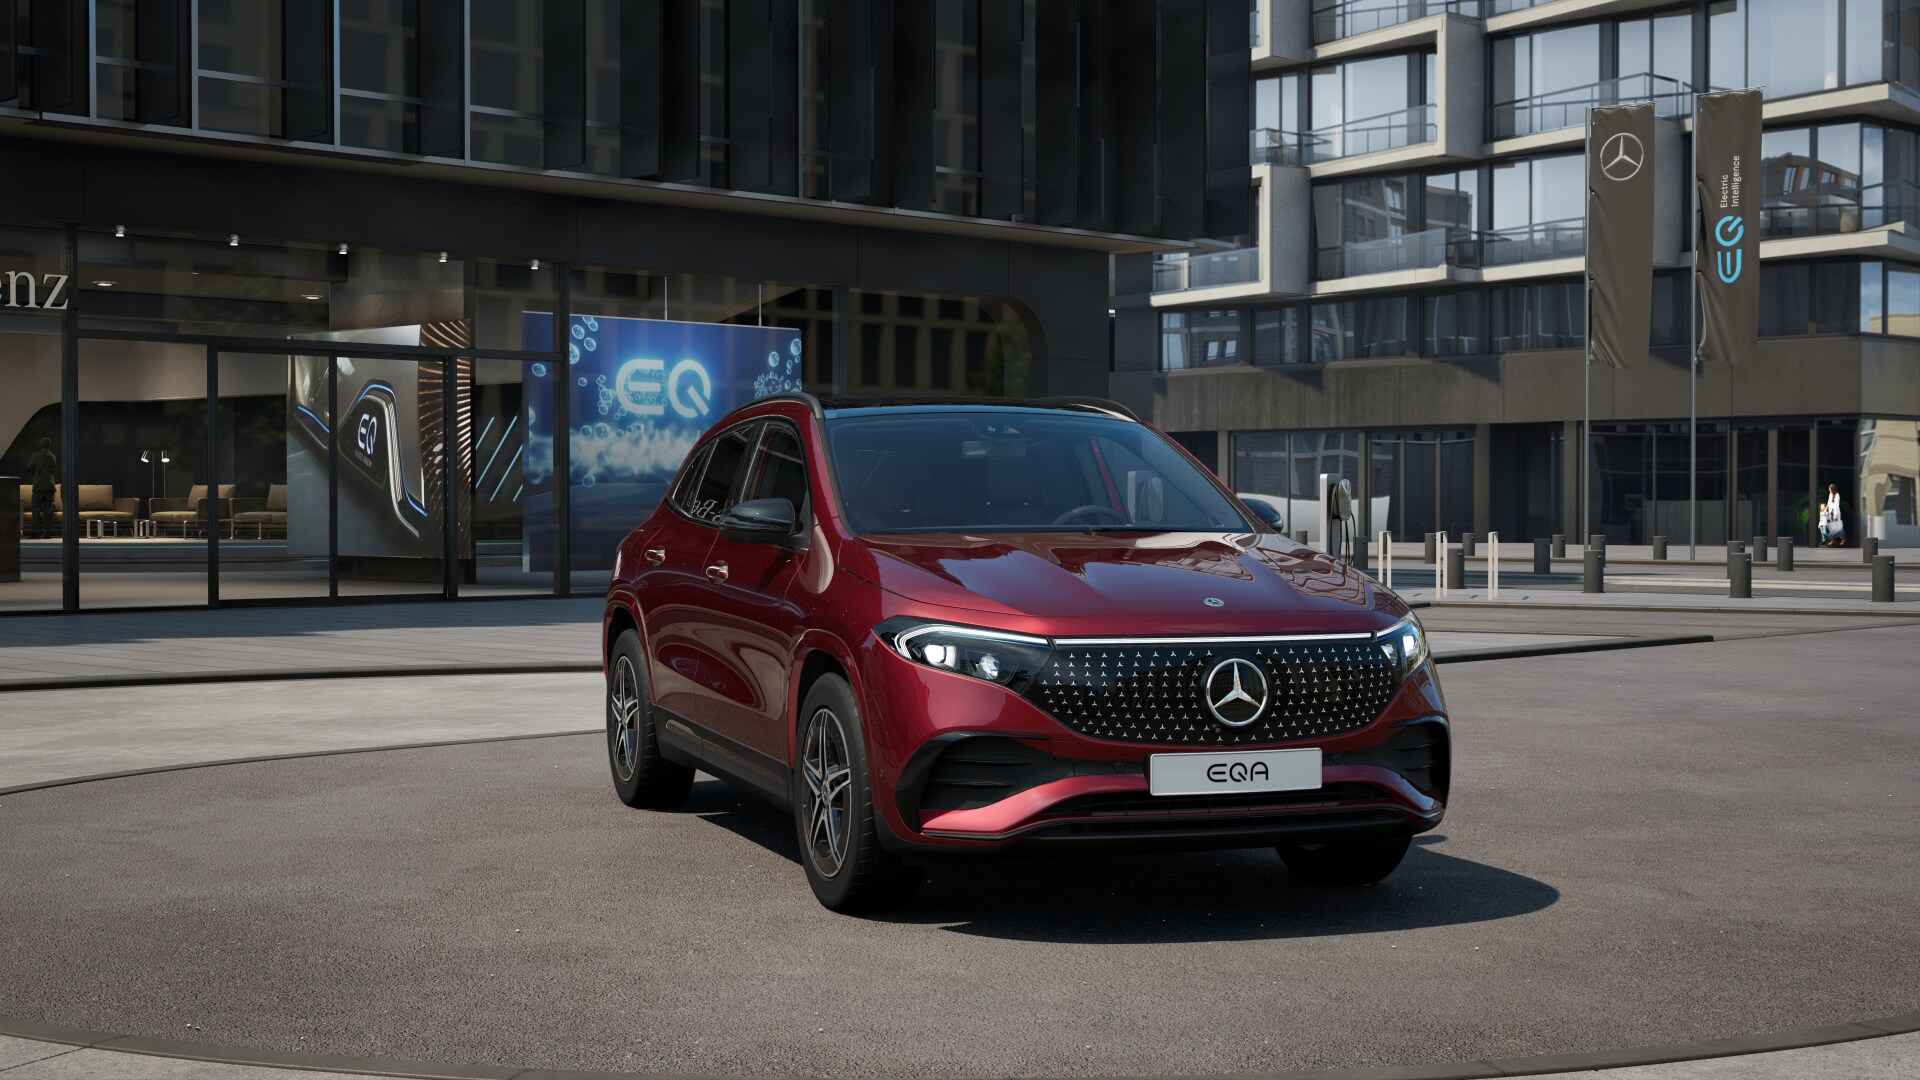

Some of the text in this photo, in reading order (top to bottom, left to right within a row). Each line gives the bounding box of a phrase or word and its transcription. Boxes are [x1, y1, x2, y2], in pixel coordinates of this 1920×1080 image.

[1720, 174, 1728, 208] Electric
[1731, 155, 1741, 207] Intelligence
[1715, 215, 1744, 284] EQ
[616, 359, 711, 417] EQ
[358, 413, 377, 454] EQ
[1207, 761, 1269, 783] EQA
